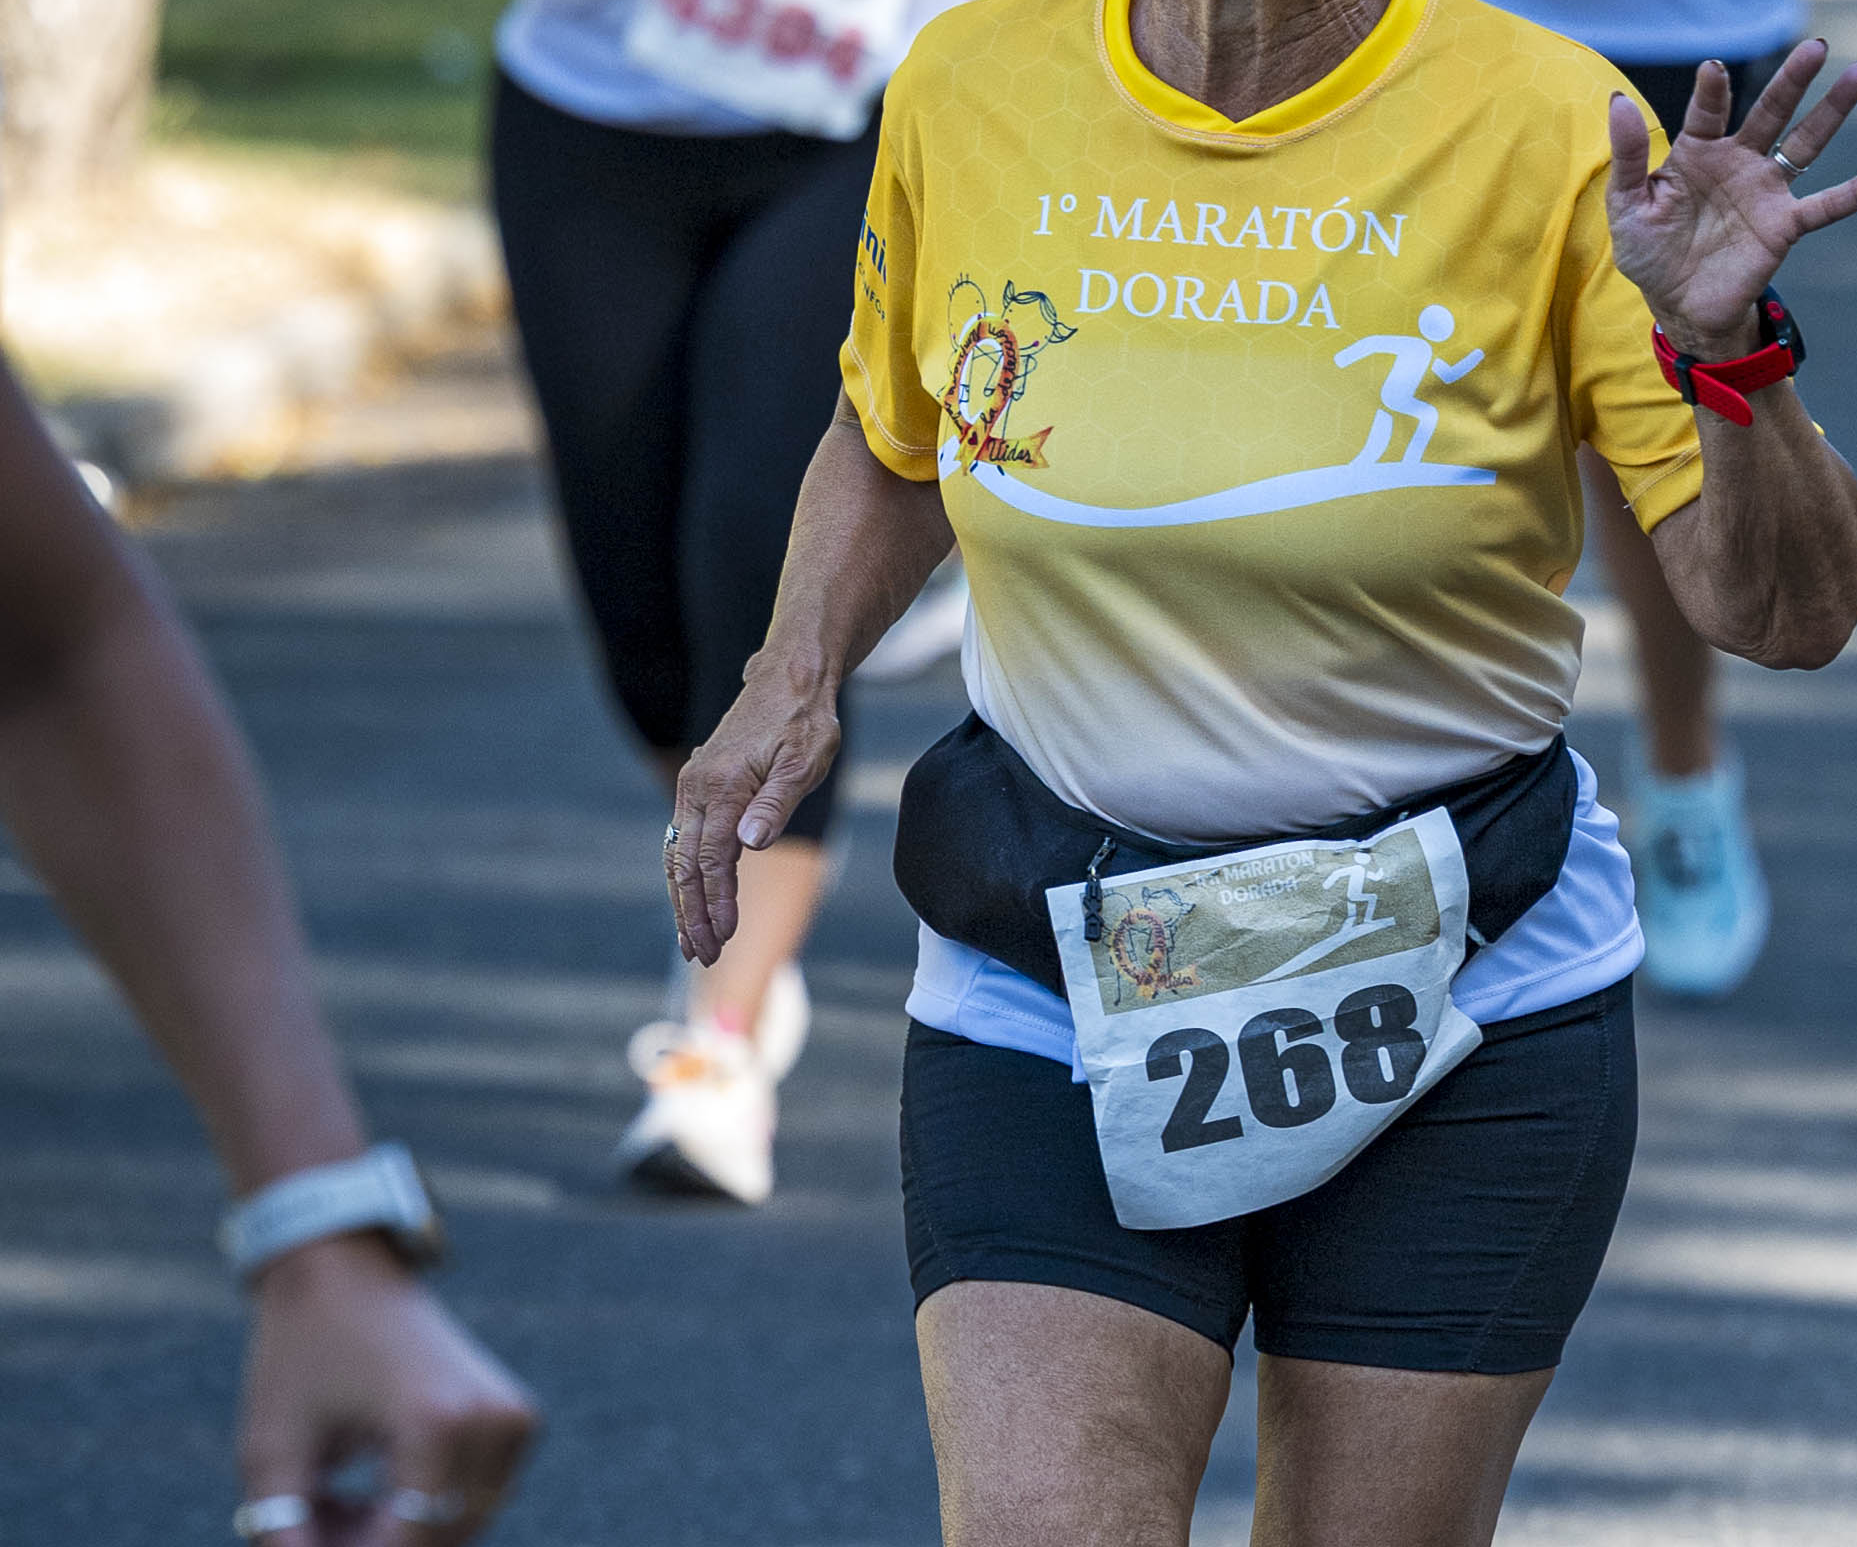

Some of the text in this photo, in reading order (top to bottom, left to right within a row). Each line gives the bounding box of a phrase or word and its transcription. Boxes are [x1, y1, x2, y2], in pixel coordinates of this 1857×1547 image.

[1090, 195, 1408, 258] MARATÓN
[1074, 268, 1341, 330] DORADA
[1219, 875, 1300, 905] DORADA
[1222, 851, 1316, 884] MARATON
[1145, 983, 1429, 1154] 268
